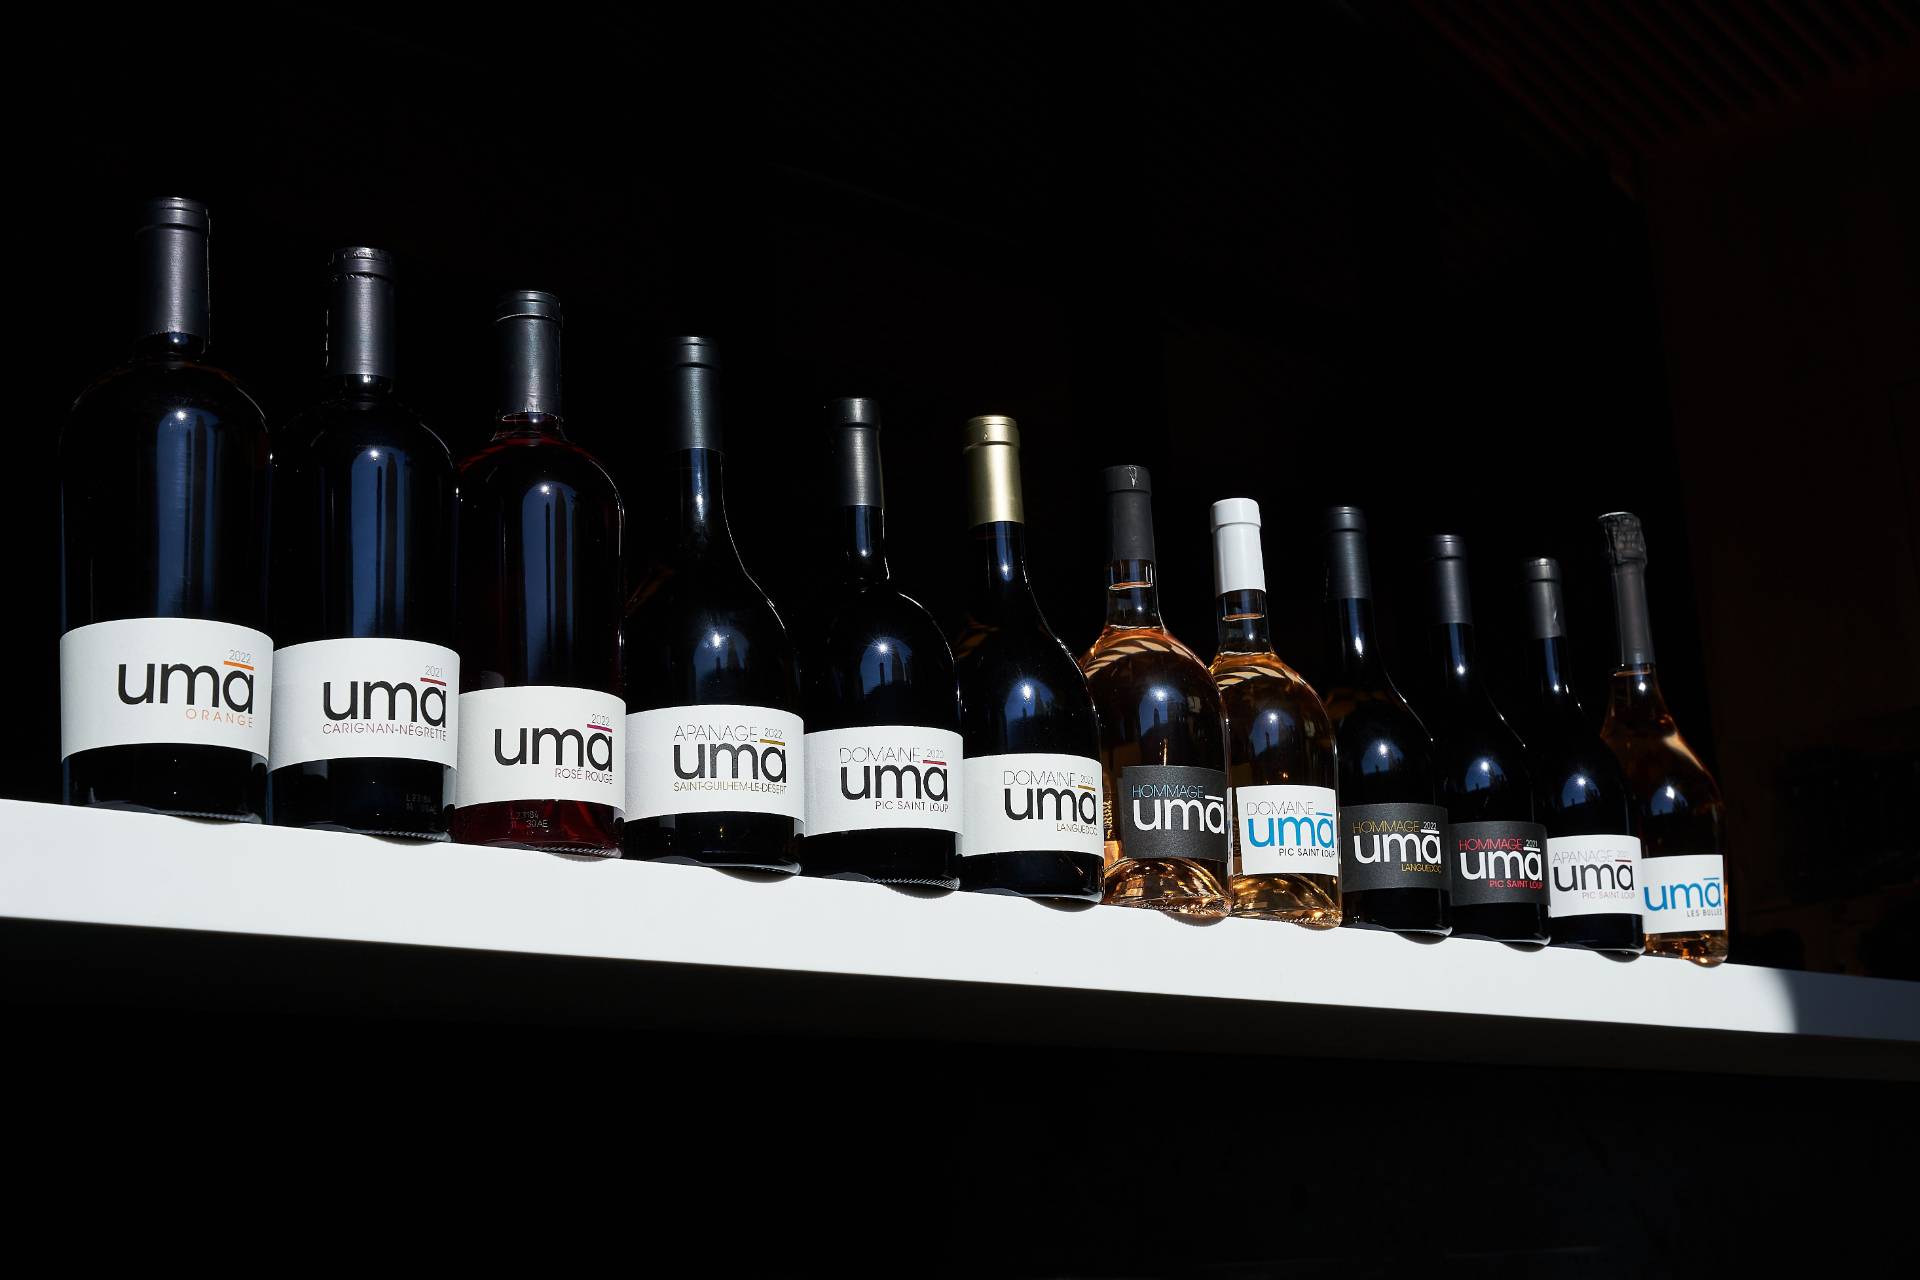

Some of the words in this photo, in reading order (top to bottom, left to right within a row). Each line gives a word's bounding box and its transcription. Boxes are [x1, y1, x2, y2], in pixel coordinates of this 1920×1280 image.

[186, 708, 254, 727] ORANGE
[592, 713, 610, 726] 2022
[323, 722, 447, 742] CARIGNAN-NÉGRETTE
[674, 725, 757, 742] APANAGE
[765, 727, 783, 739] 2022
[840, 747, 920, 763] DOMAINE
[555, 767, 582, 780] ROSÉ
[586, 769, 612, 784] ROUGE
[1004, 770, 1076, 787] DOMAINE
[1133, 784, 1203, 799] HOMMAGE
[876, 801, 893, 810] PIC
[898, 801, 925, 811] SAINT
[929, 802, 949, 812] LOUP
[1247, 801, 1314, 815] DOMAINE
[1057, 823, 1097, 836] LANGUEDOC
[1353, 821, 1420, 832] HOMMAGE
[1459, 839, 1523, 851] HOMMAGE
[1279, 848, 1294, 856] PIC
[1298, 848, 1318, 857] SAINT
[1321, 849, 1335, 858] LOUP
[1553, 849, 1614, 864] APANAGE
[1401, 864, 1442, 874] LANGUEDOC
[1489, 879, 1504, 888] PIC
[1507, 880, 1528, 888] SAINT
[1583, 891, 1597, 899] PIC
[1599, 891, 1619, 899] SAINT
[1687, 910, 1700, 919] LES
